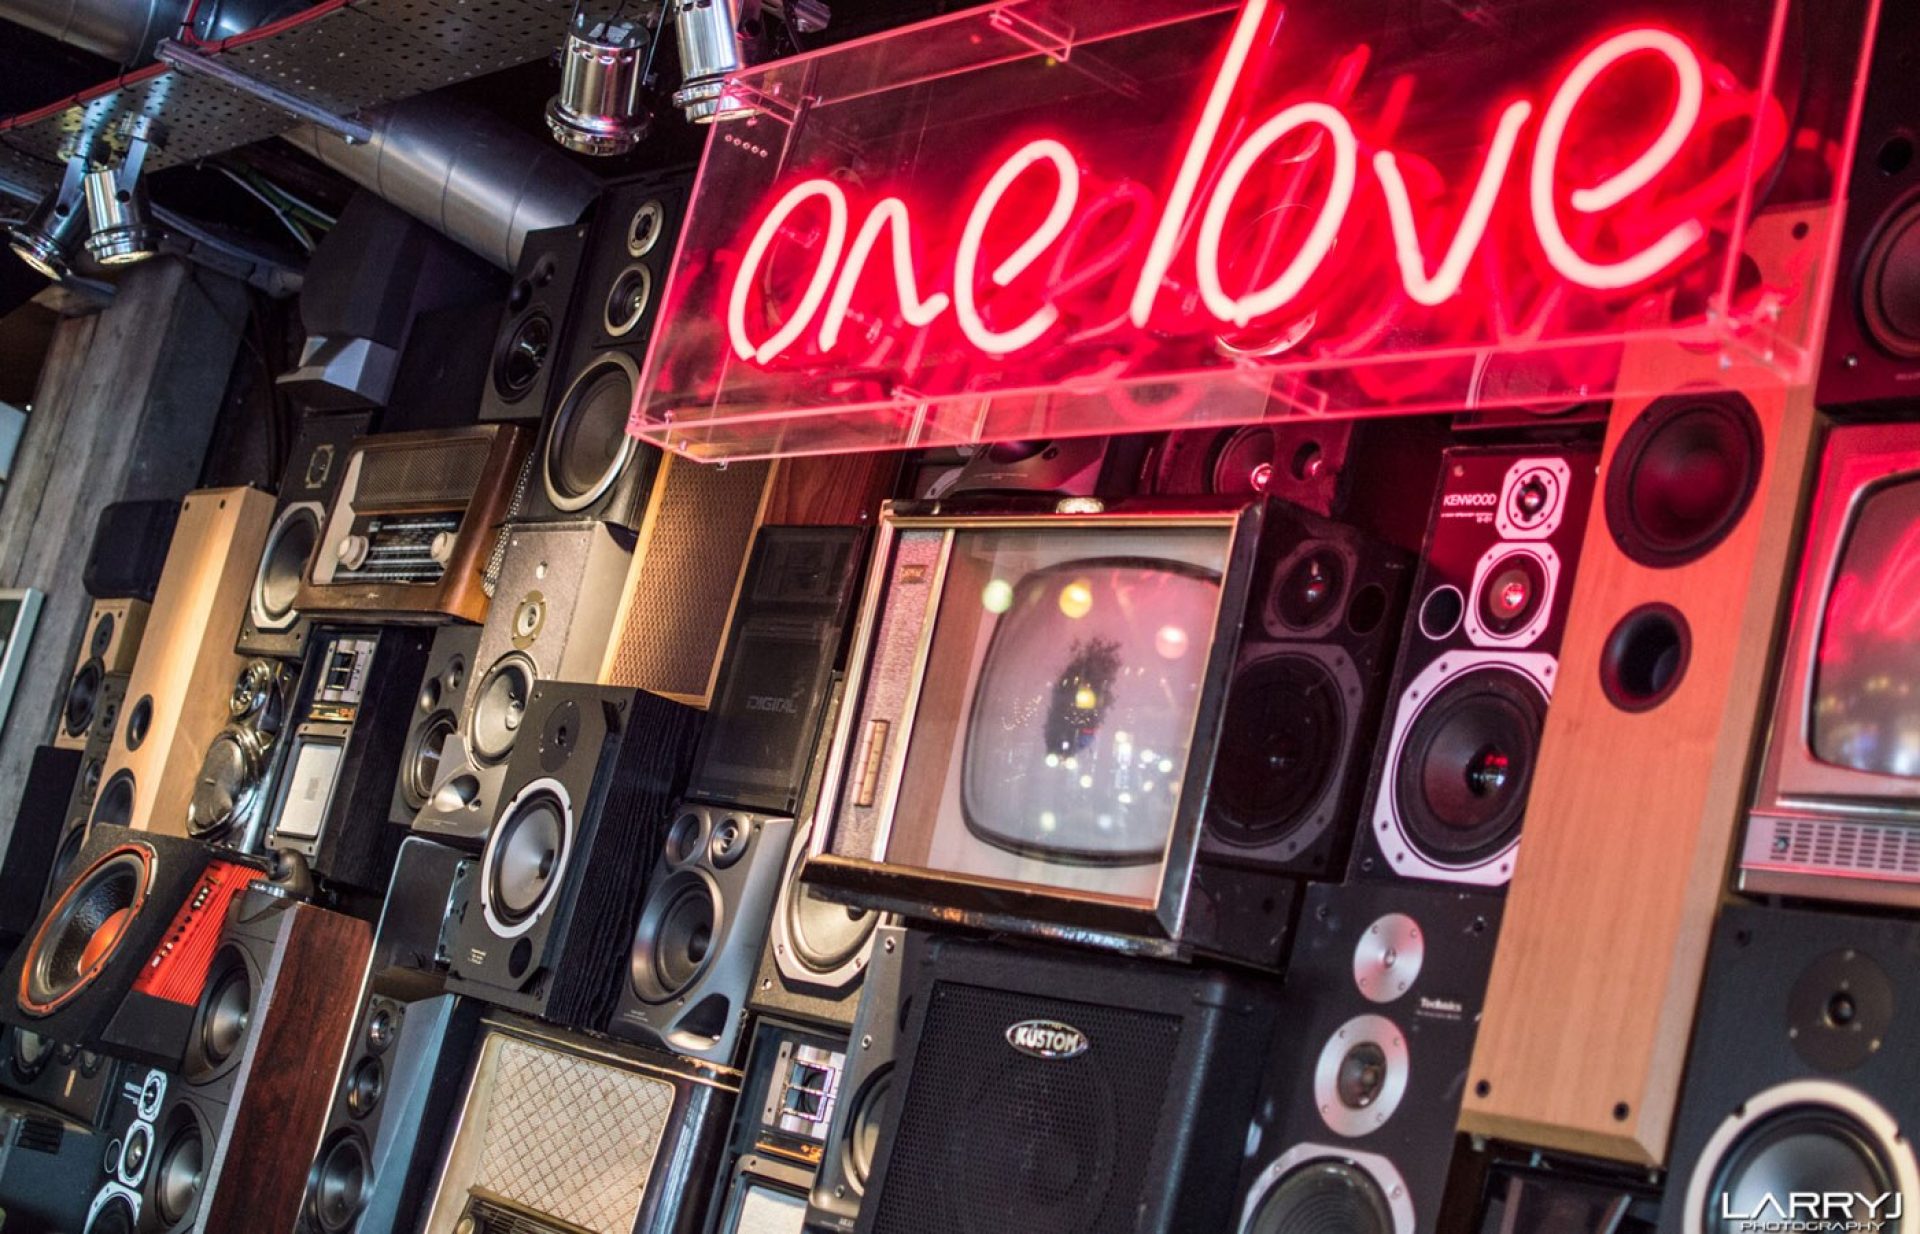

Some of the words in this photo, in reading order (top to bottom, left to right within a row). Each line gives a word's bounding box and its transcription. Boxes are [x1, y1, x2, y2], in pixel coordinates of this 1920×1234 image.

[729, 140, 1078, 364] one
[1131, 0, 1702, 328] love
[1443, 493, 1497, 506] KENWOOD
[746, 695, 797, 714] DIGITAL
[1014, 1026, 1079, 1053] KUSTOM
